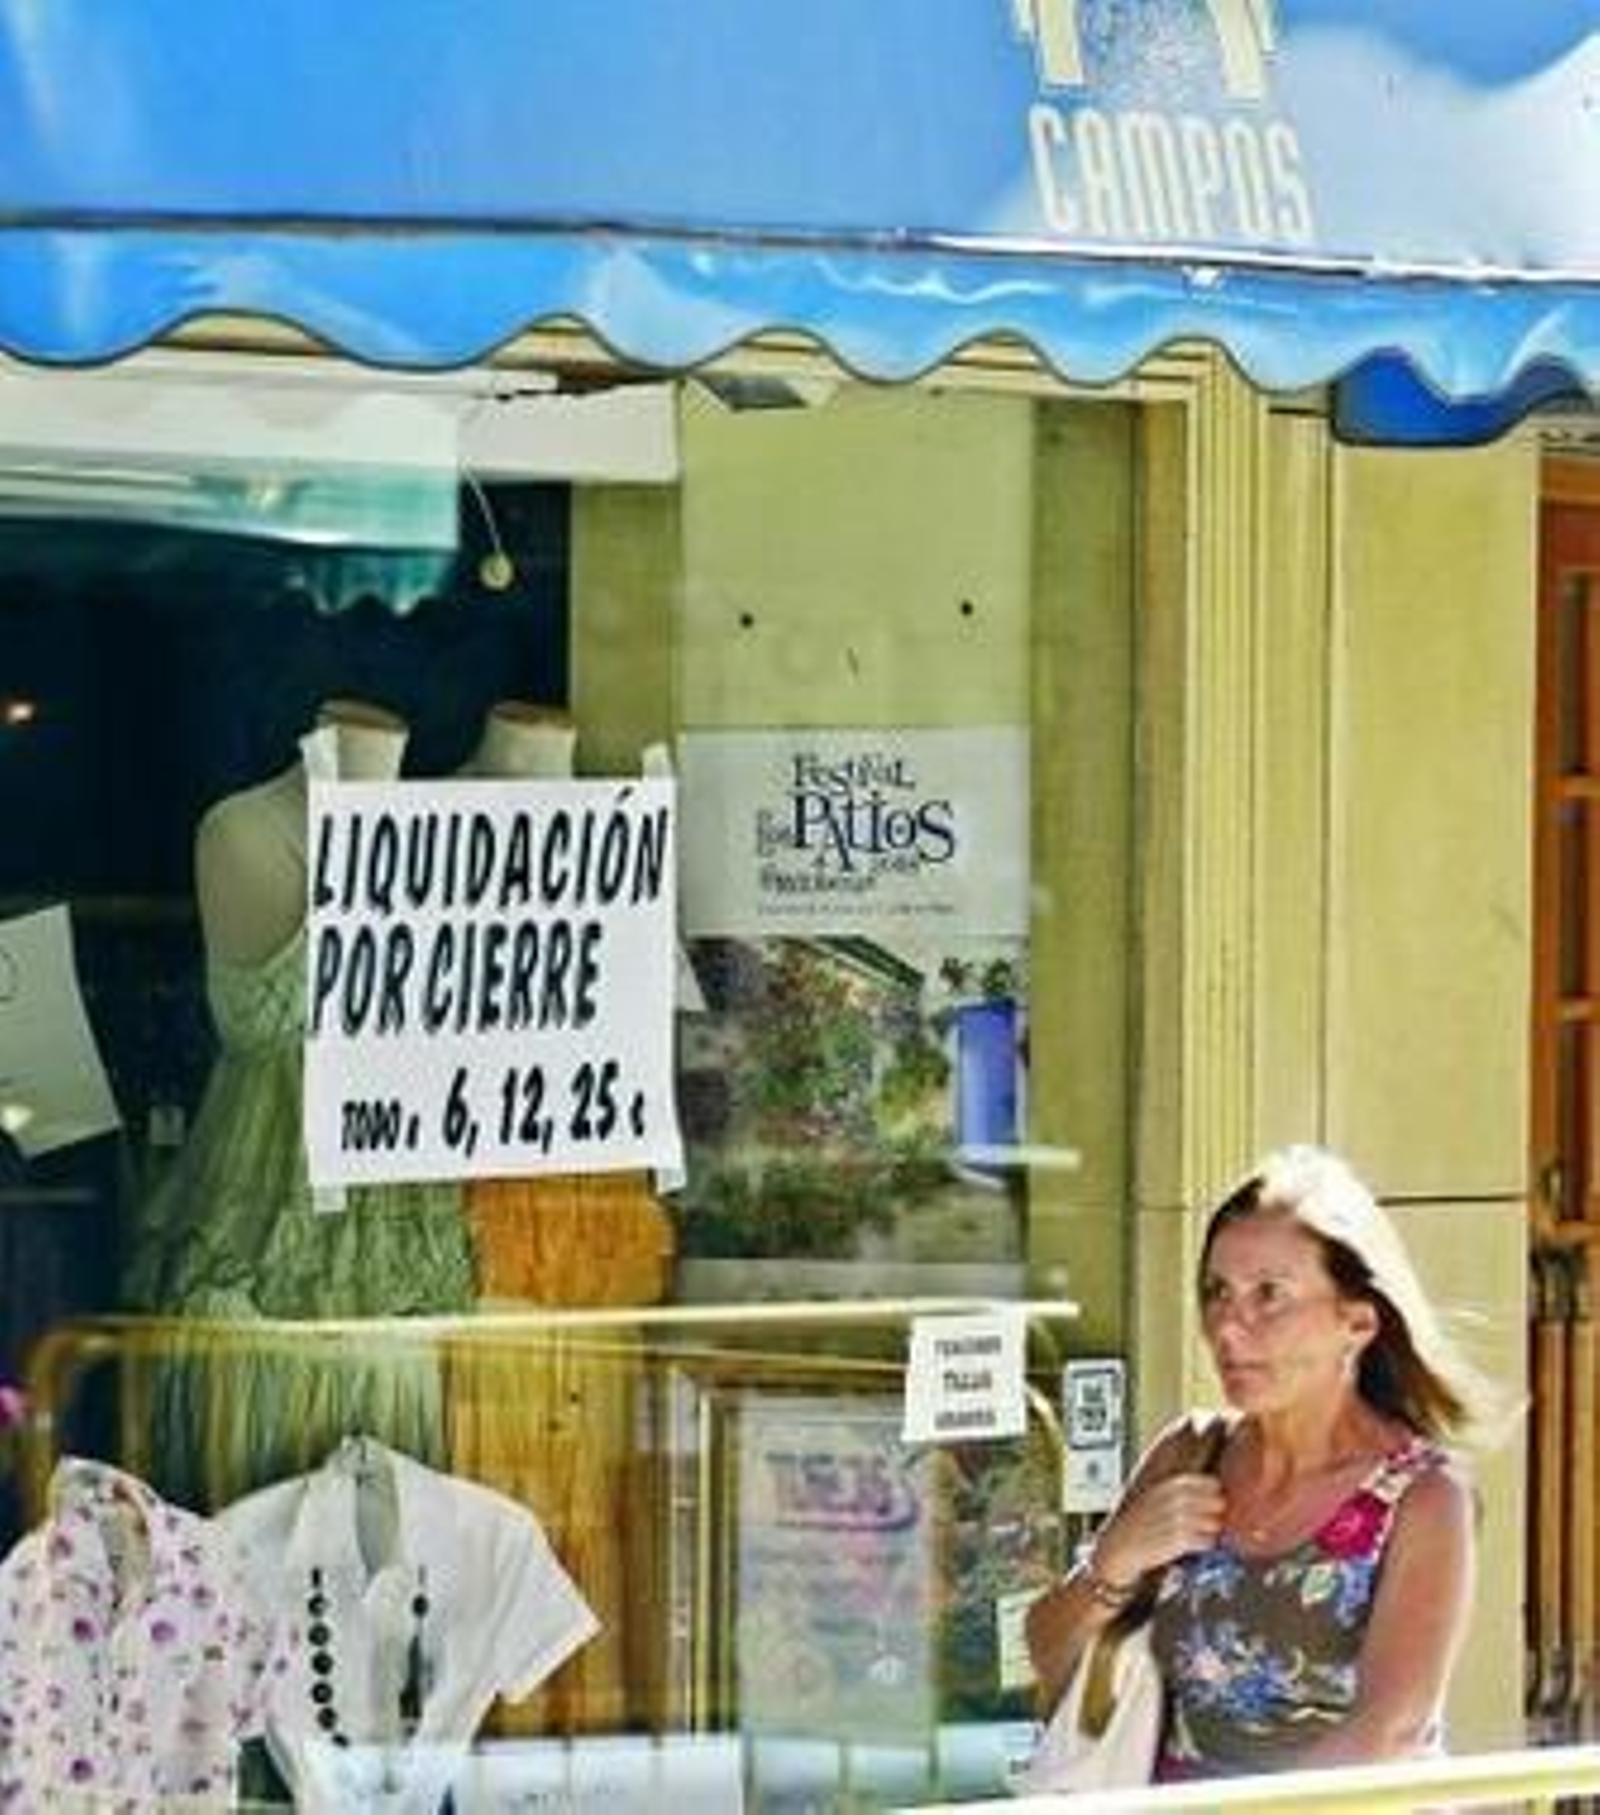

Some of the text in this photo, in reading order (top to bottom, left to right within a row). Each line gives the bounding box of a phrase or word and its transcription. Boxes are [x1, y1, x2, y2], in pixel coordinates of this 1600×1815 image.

[1029, 104, 1314, 240] CAMPOS
[313, 786, 668, 914] LIQUIDACIÓN
[312, 919, 603, 1034] POR CIERRE
[341, 1099, 401, 1151] TODO
[443, 1067, 478, 1157] 6,
[500, 1066, 553, 1155] 12,
[570, 1059, 619, 1141] 25
